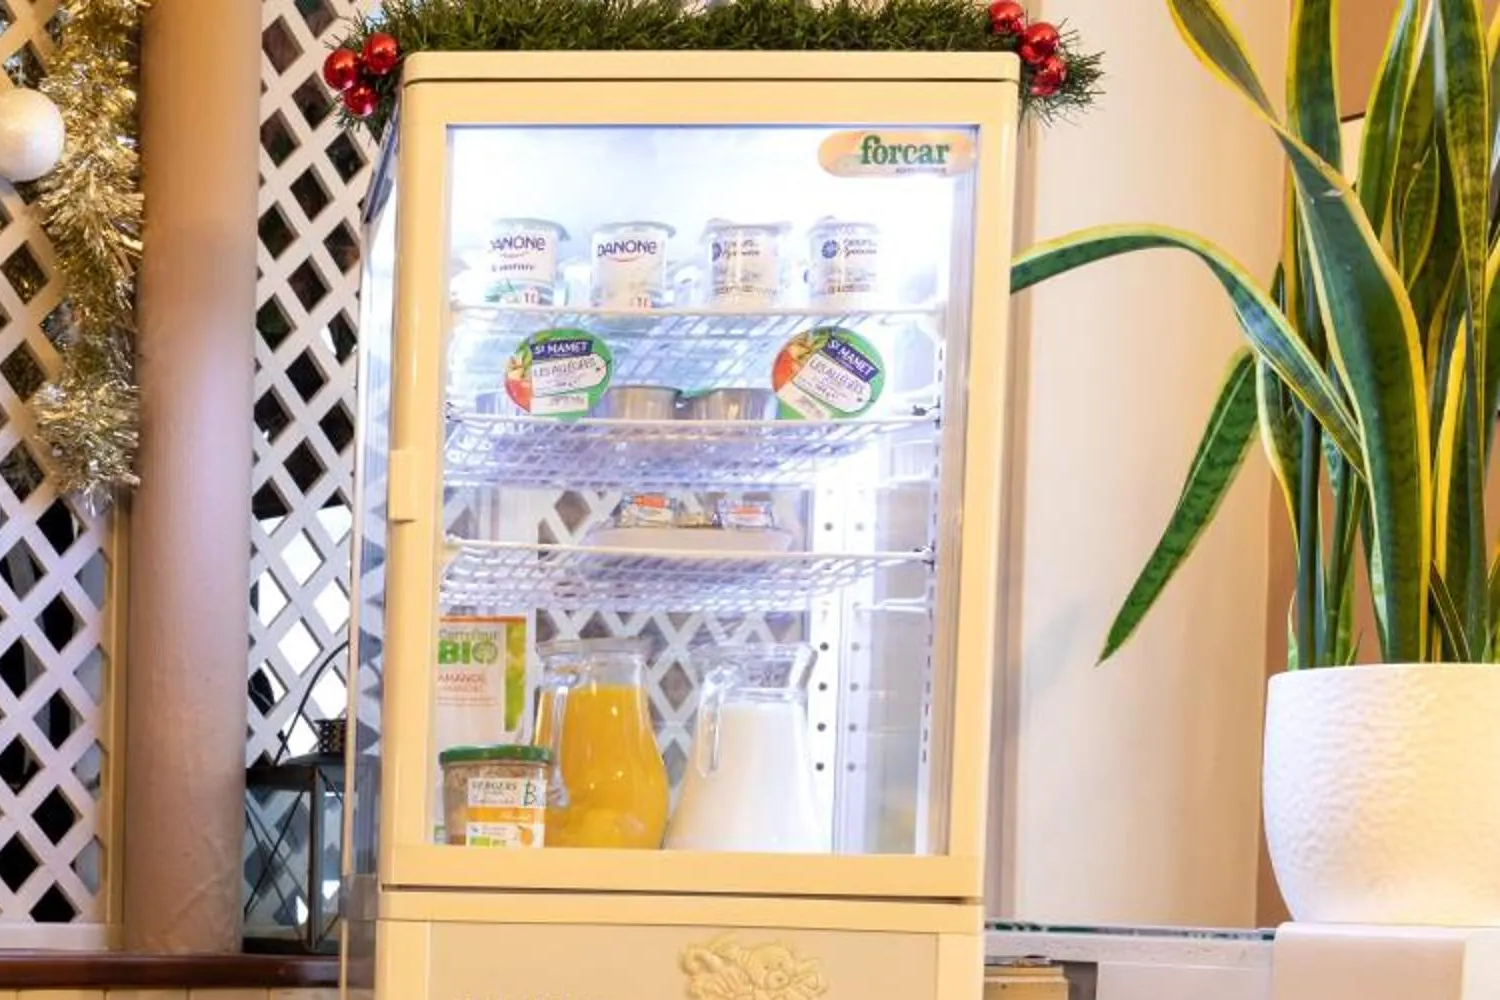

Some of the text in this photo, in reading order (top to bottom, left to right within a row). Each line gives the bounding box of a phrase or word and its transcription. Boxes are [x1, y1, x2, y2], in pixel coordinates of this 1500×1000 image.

[860, 134, 950, 165] forcar
[547, 341, 588, 354] MAMET
[838, 346, 876, 377] MAMET
[438, 640, 498, 665] BIO
